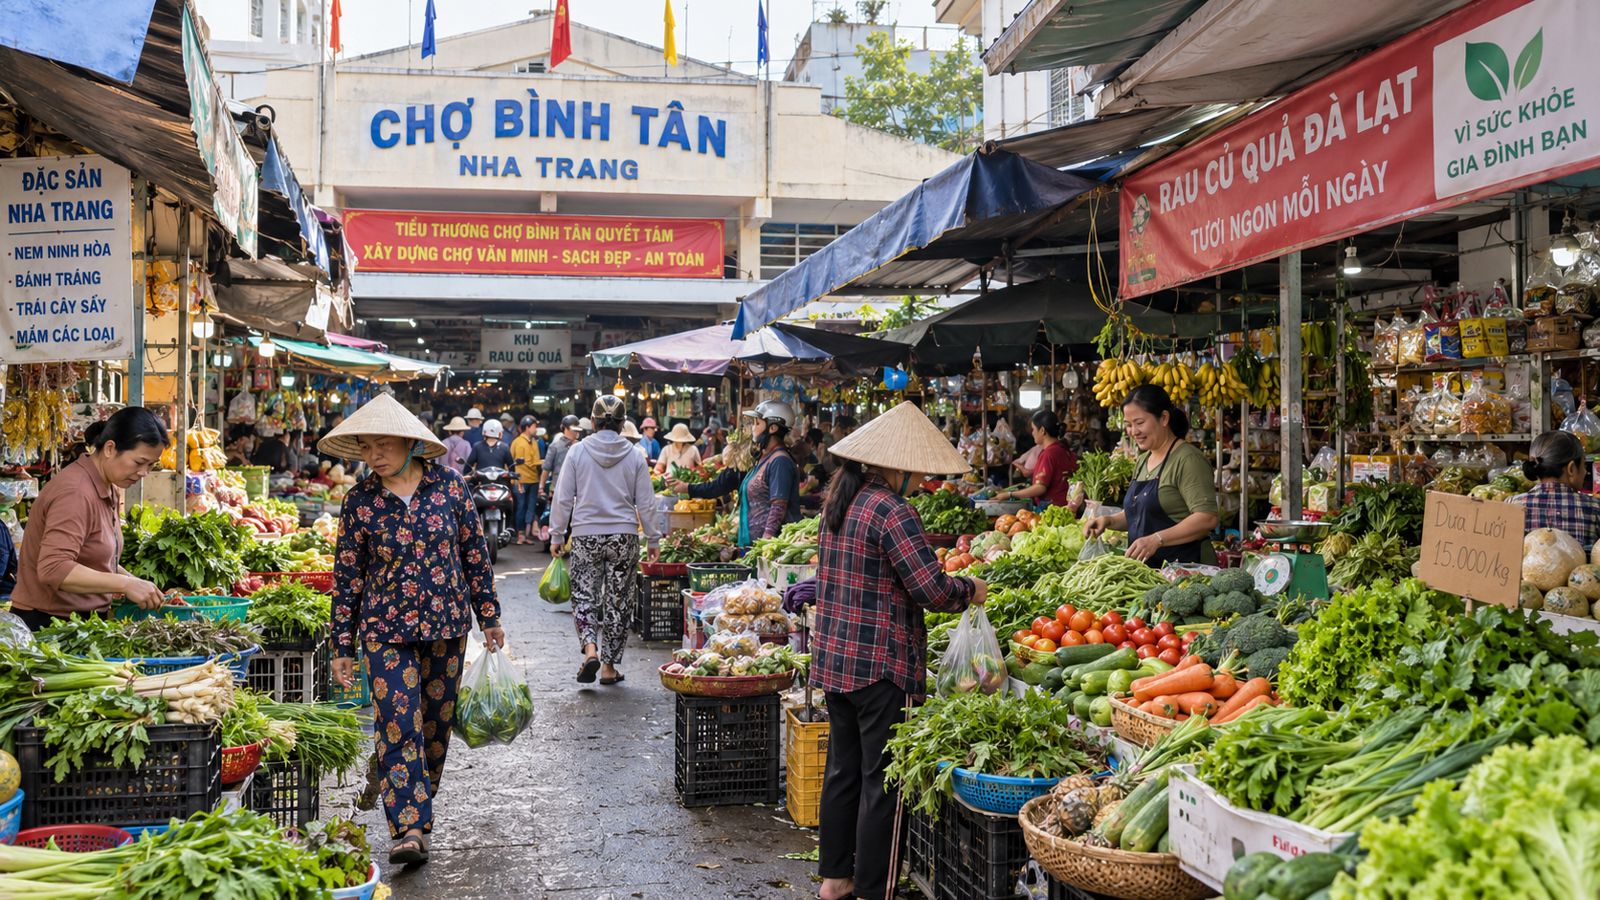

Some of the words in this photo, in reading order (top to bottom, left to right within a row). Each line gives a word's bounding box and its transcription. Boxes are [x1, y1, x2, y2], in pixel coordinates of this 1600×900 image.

[370, 97, 475, 149] CHỢ
[494, 88, 611, 141] BÌNH
[632, 100, 727, 158] TÂN
[1454, 120, 1471, 144] VÌ
[1476, 110, 1512, 137] SỨC
[1519, 86, 1575, 123] KHỎE
[1159, 168, 1199, 215] RAU
[1205, 142, 1234, 195] CỦ
[1241, 113, 1296, 184] QUẢ
[1303, 92, 1347, 155] ĐÀ
[1356, 66, 1418, 134] LẠT
[1447, 154, 1479, 178] GIA
[1484, 136, 1534, 168] ĐÌNH
[1541, 119, 1587, 151] BẠN
[22, 166, 59, 195] ĐẶC
[65, 162, 102, 190] SẢN
[459, 155, 522, 177] NHA
[536, 157, 639, 180] TRANG
[8, 203, 46, 224] NHA
[51, 199, 113, 222] TRANG
[1190, 217, 1225, 255] TƯƠI
[1230, 200, 1277, 241] NGON
[1283, 174, 1320, 224] MỖI
[1326, 159, 1388, 210] NGÀY
[431, 222, 490, 239] THƯƠNG
[493, 223, 523, 243] CHỢ
[526, 221, 560, 240] BÌNH
[564, 223, 592, 241] TÂN
[596, 222, 640, 243] QUYẾT
[15, 246, 43, 260] NEM
[47, 244, 79, 259] NINH
[83, 239, 111, 257] HÒA
[363, 241, 393, 260] XÂY
[397, 244, 438, 264] DỰNG
[442, 246, 474, 265] CHỢ
[477, 244, 507, 262] VĂN
[511, 249, 549, 263] MINH
[562, 250, 600, 267] SẠCH
[604, 250, 632, 268] ĐẸP
[644, 251, 664, 266] AN
[15, 270, 52, 288] BÁNH
[16, 298, 46, 316] TRÁI
[50, 297, 77, 314] CÂY
[81, 294, 106, 313] SẤY
[52, 324, 80, 343] CÁC
[84, 327, 115, 344] LOẠI
[514, 334, 539, 345] KHU
[489, 351, 513, 363] RAU
[517, 348, 533, 363] CỦ
[1473, 507, 1507, 539] Lưới
[1432, 540, 1511, 587] 15.000/kg
